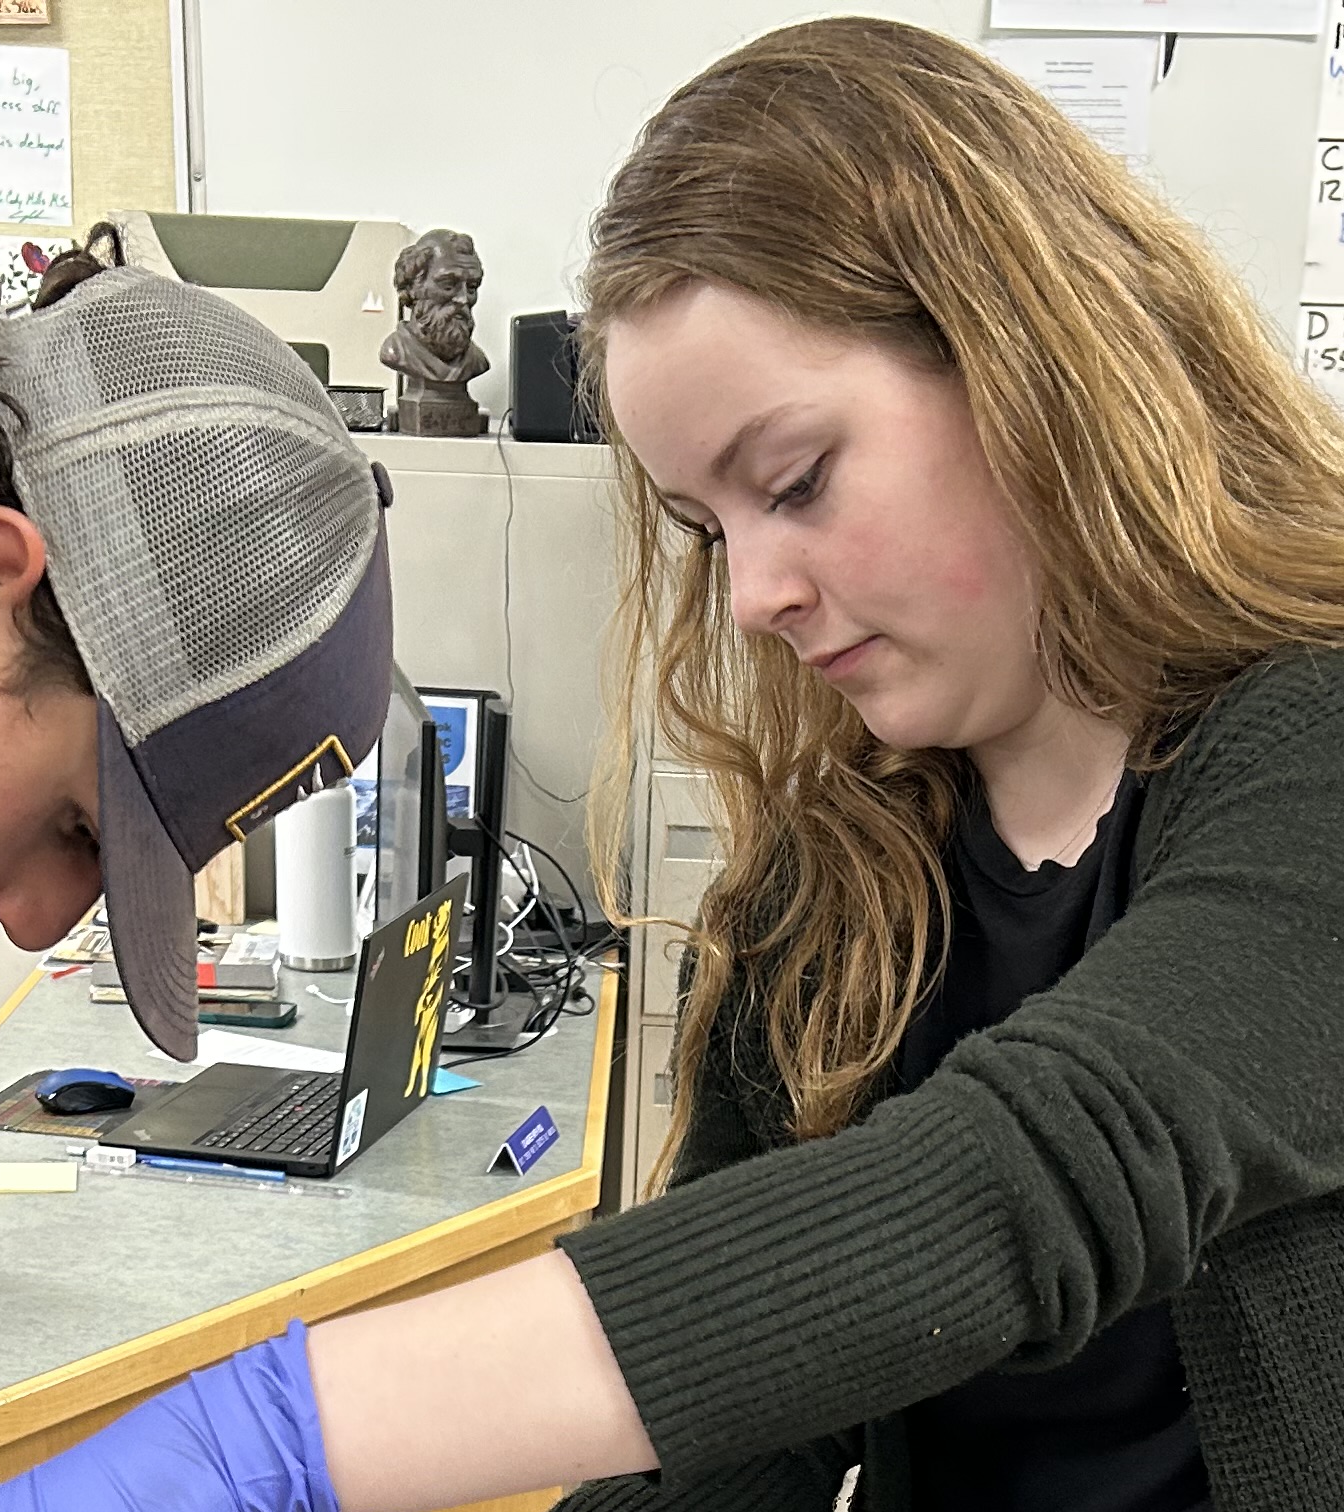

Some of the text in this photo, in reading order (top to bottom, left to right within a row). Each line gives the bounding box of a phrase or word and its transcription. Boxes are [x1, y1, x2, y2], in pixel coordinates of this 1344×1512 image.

[13, 67, 40, 95] big,
[32, 99, 63, 115] stuff
[19, 133, 65, 157] delayed
[1321, 145, 1344, 171] C
[1307, 311, 1329, 341] D
